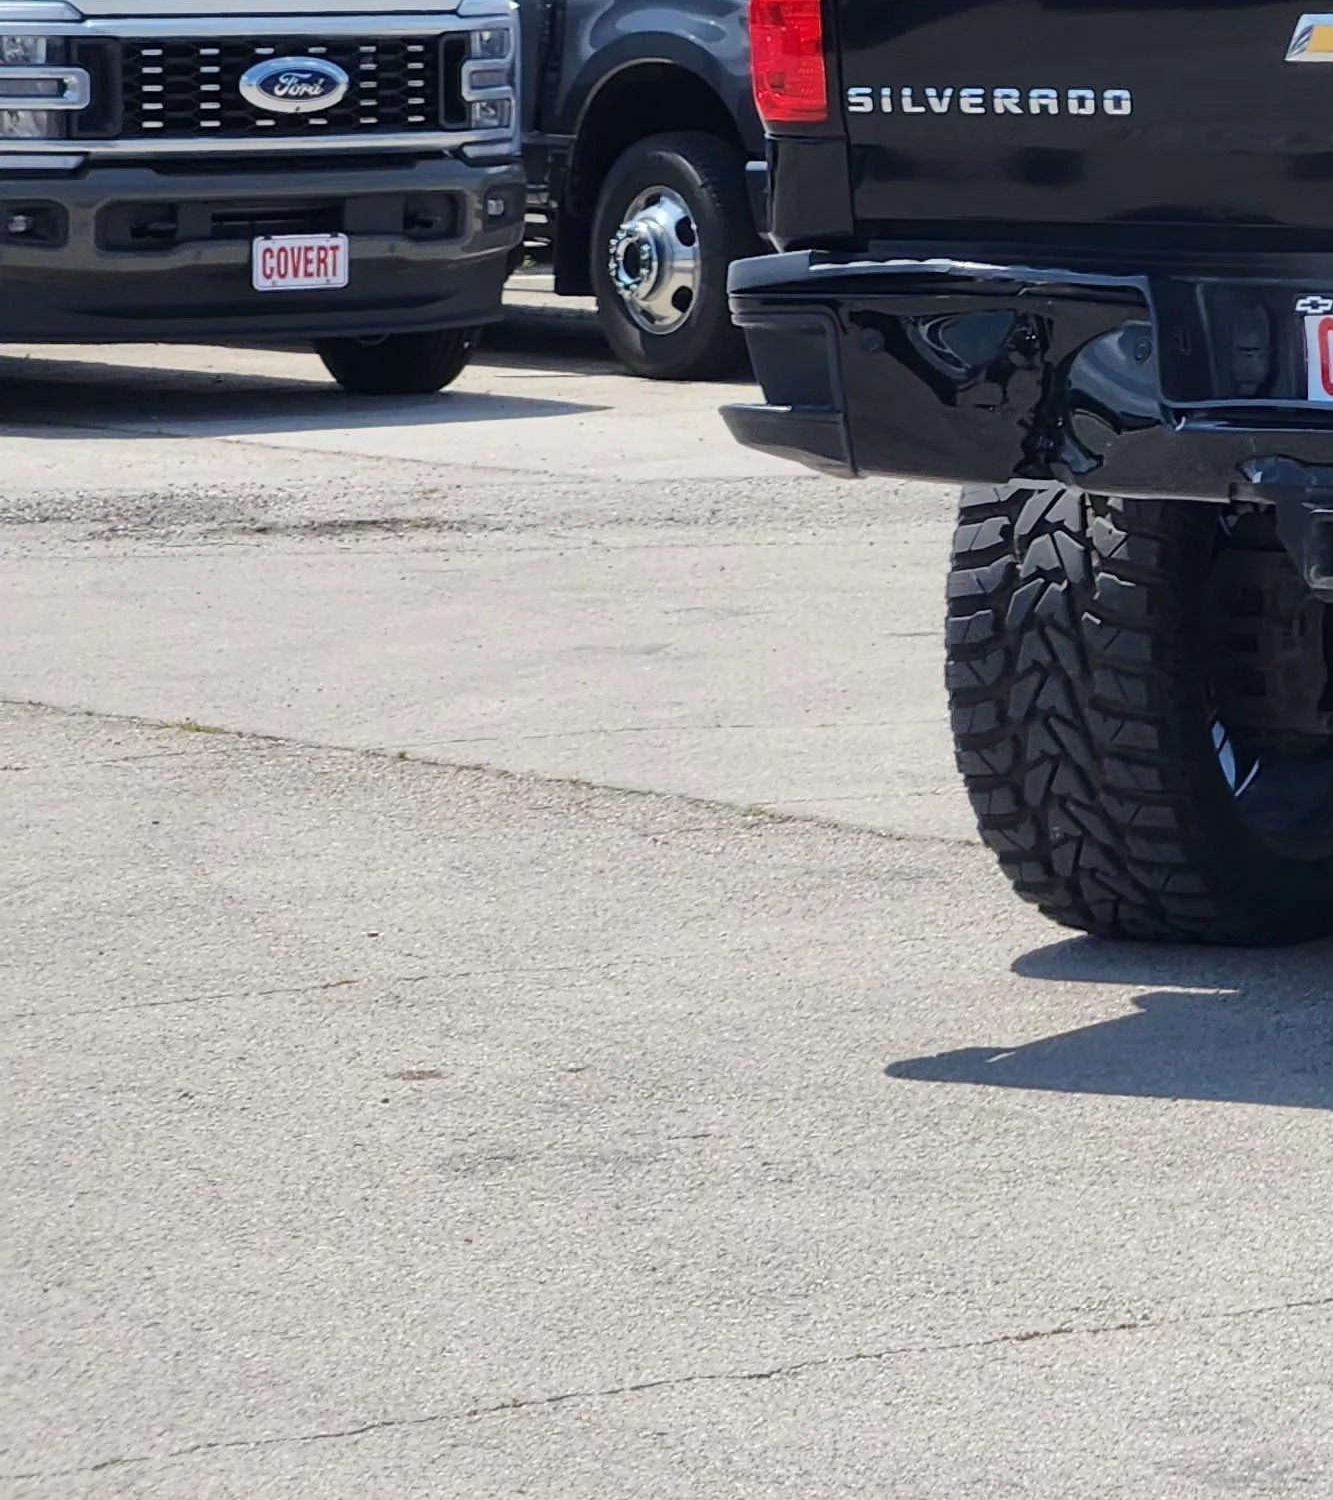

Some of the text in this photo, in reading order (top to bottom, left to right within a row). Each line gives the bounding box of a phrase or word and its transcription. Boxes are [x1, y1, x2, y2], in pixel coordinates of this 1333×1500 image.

[273, 72, 324, 97] Ford
[847, 87, 1132, 115] SILVERADO
[262, 245, 339, 280] COVERT
